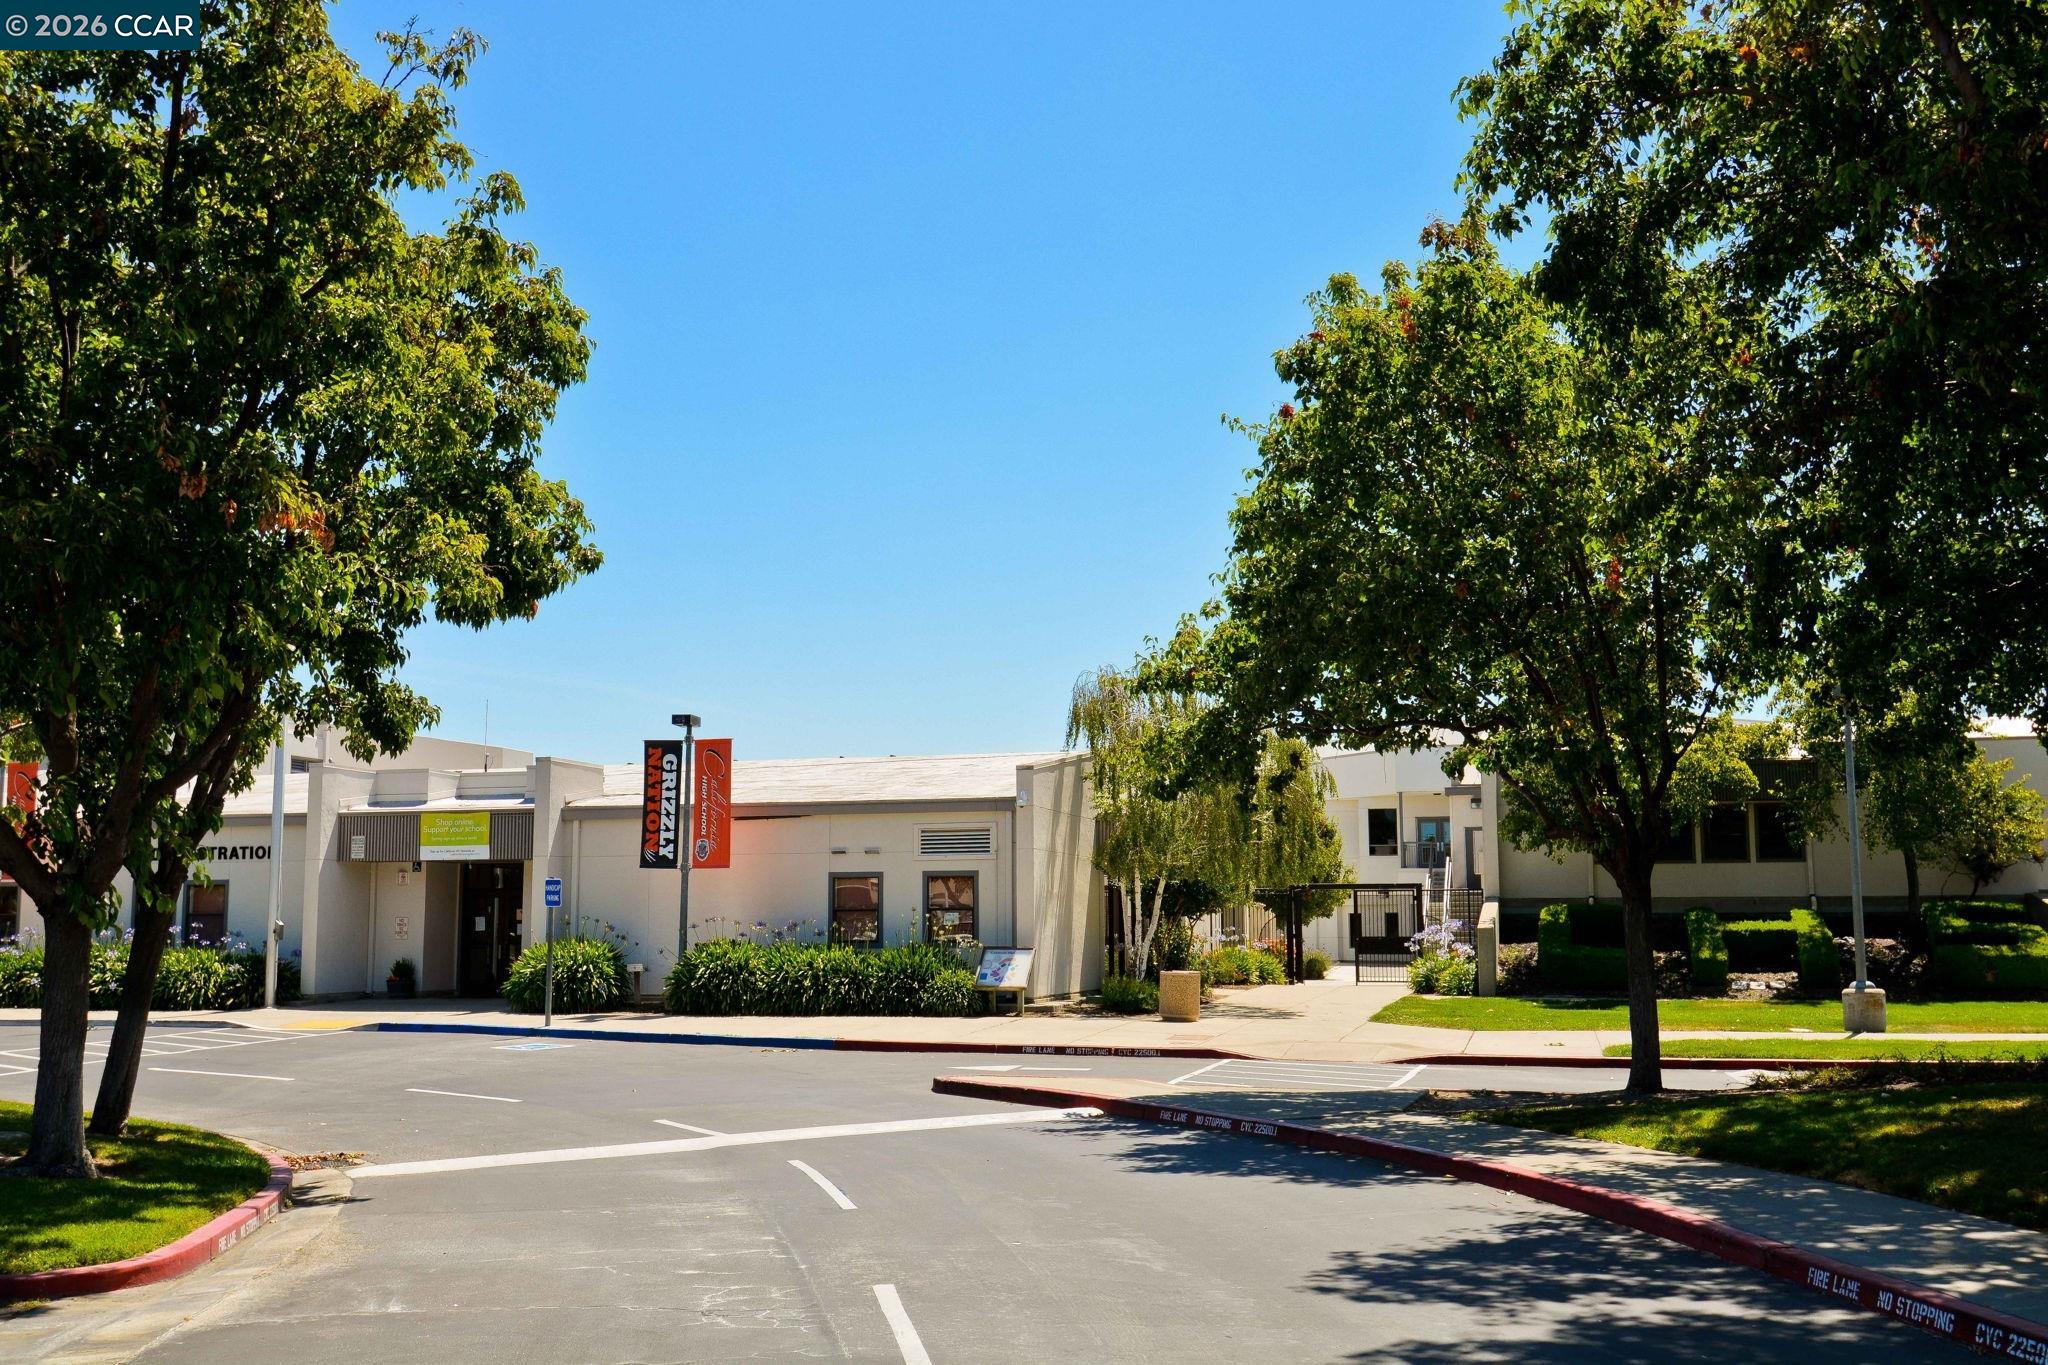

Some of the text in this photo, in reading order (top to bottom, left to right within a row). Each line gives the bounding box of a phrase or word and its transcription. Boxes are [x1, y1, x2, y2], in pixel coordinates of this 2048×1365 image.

[423, 825, 449, 834] Support
[449, 826, 464, 834] your
[644, 747, 663, 852] NATION
[659, 753, 678, 860] GRIZZLY
[703, 748, 728, 852] California
[1022, 1045, 1036, 1053] FIRE
[1038, 1046, 1055, 1054] LANE
[1065, 1047, 1075, 1055] NO
[1159, 1110, 1172, 1120] FIRE
[1173, 1111, 1189, 1123] LANE
[1195, 1115, 1203, 1125] NO
[1204, 1116, 1232, 1129] STOPPING
[1240, 1121, 1254, 1132] CVC
[1807, 1266, 1829, 1290] FIRE
[1833, 1274, 1861, 1301] LANE
[1877, 1290, 1893, 1312] NO
[1896, 1296, 1955, 1333] STOPPING
[1975, 1322, 2003, 1349] CVC
